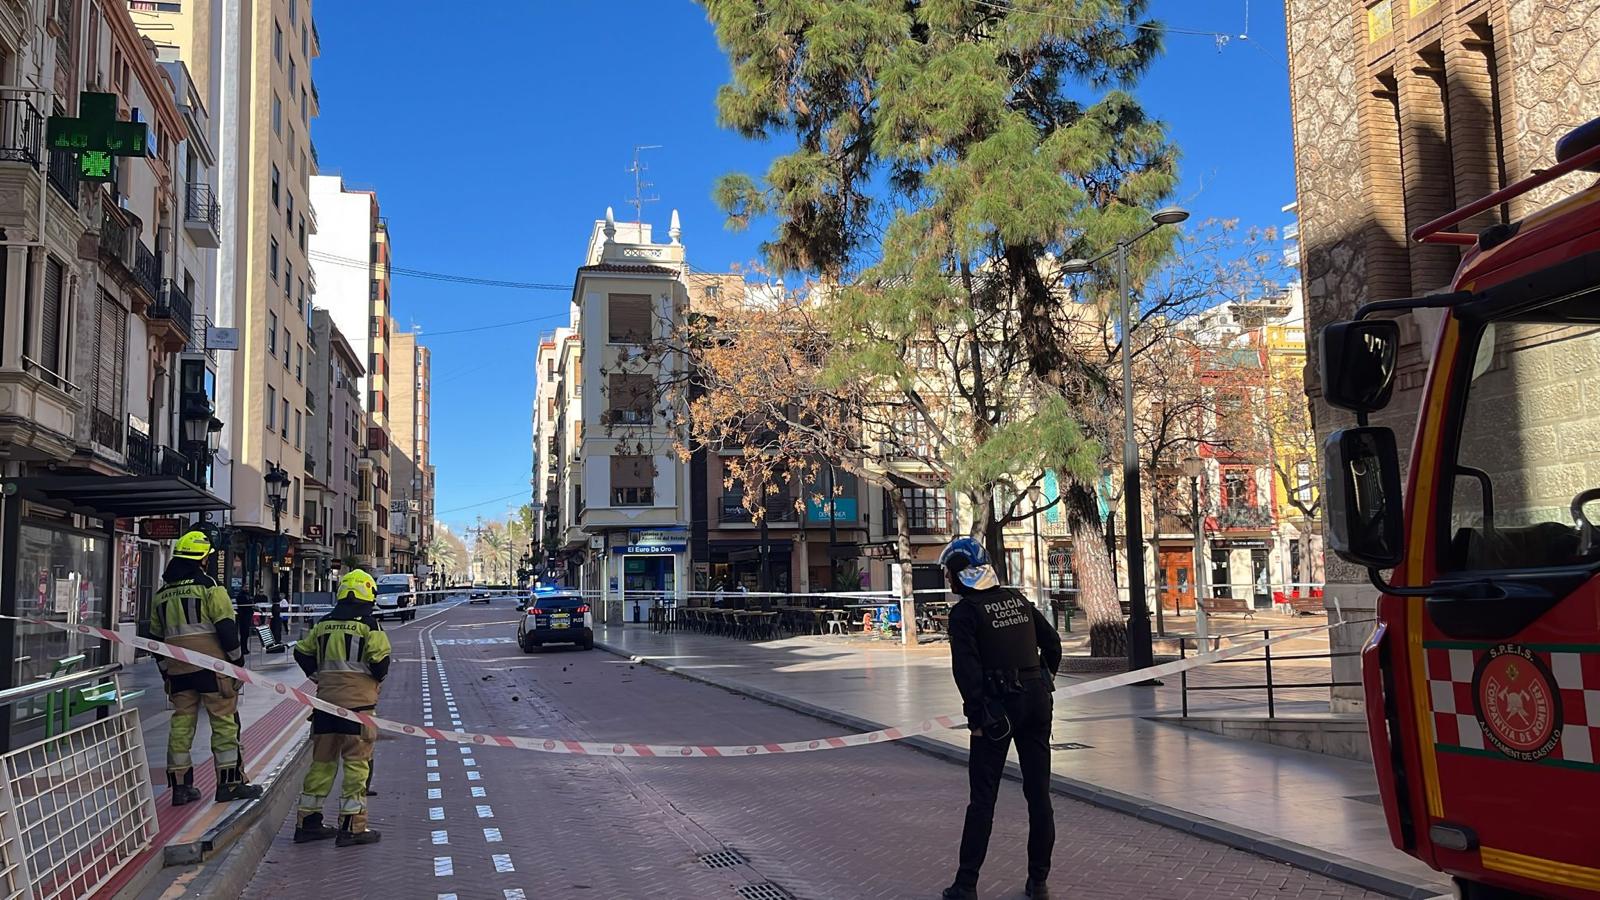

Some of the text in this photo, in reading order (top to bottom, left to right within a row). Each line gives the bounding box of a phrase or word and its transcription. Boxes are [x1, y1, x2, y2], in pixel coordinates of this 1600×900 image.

[992, 614, 1029, 628] Castelló
[994, 608, 1021, 619] LOCAL
[1490, 644, 1534, 662] S.P.E.I.S.
[1488, 682, 1547, 742] COMPANYIA DE BOMBERS
[1480, 721, 1520, 759] AJUNTAMENT
[1522, 752, 1532, 760] DE
